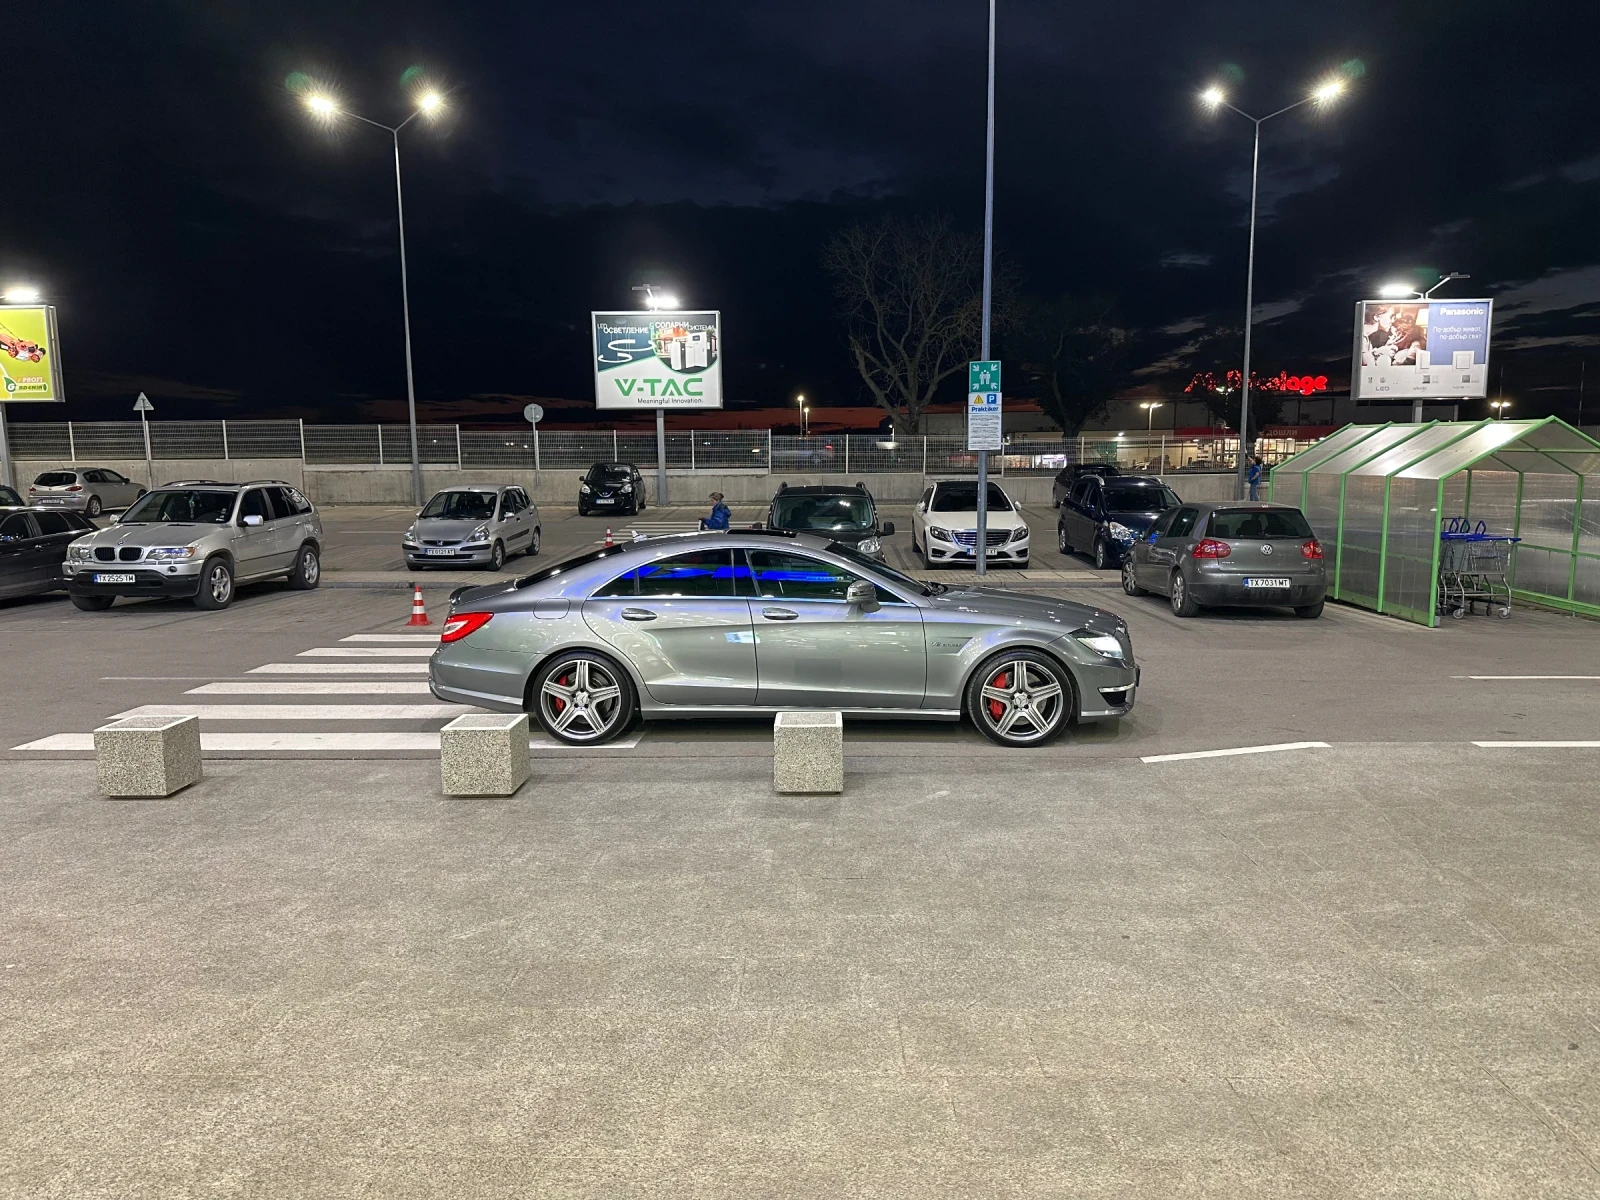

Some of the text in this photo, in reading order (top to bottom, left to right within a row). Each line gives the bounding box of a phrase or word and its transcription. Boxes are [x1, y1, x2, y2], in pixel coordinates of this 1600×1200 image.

[1440, 307, 1484, 316] Panasonic
[603, 326, 649, 334] ОСВЕТЛЕНИЕ
[655, 321, 689, 329] СОЛАРНИ
[614, 378, 704, 397] V-TAC
[638, 398, 670, 406] Meaningful
[1250, 579, 1288, 587] TX 7031 MT
